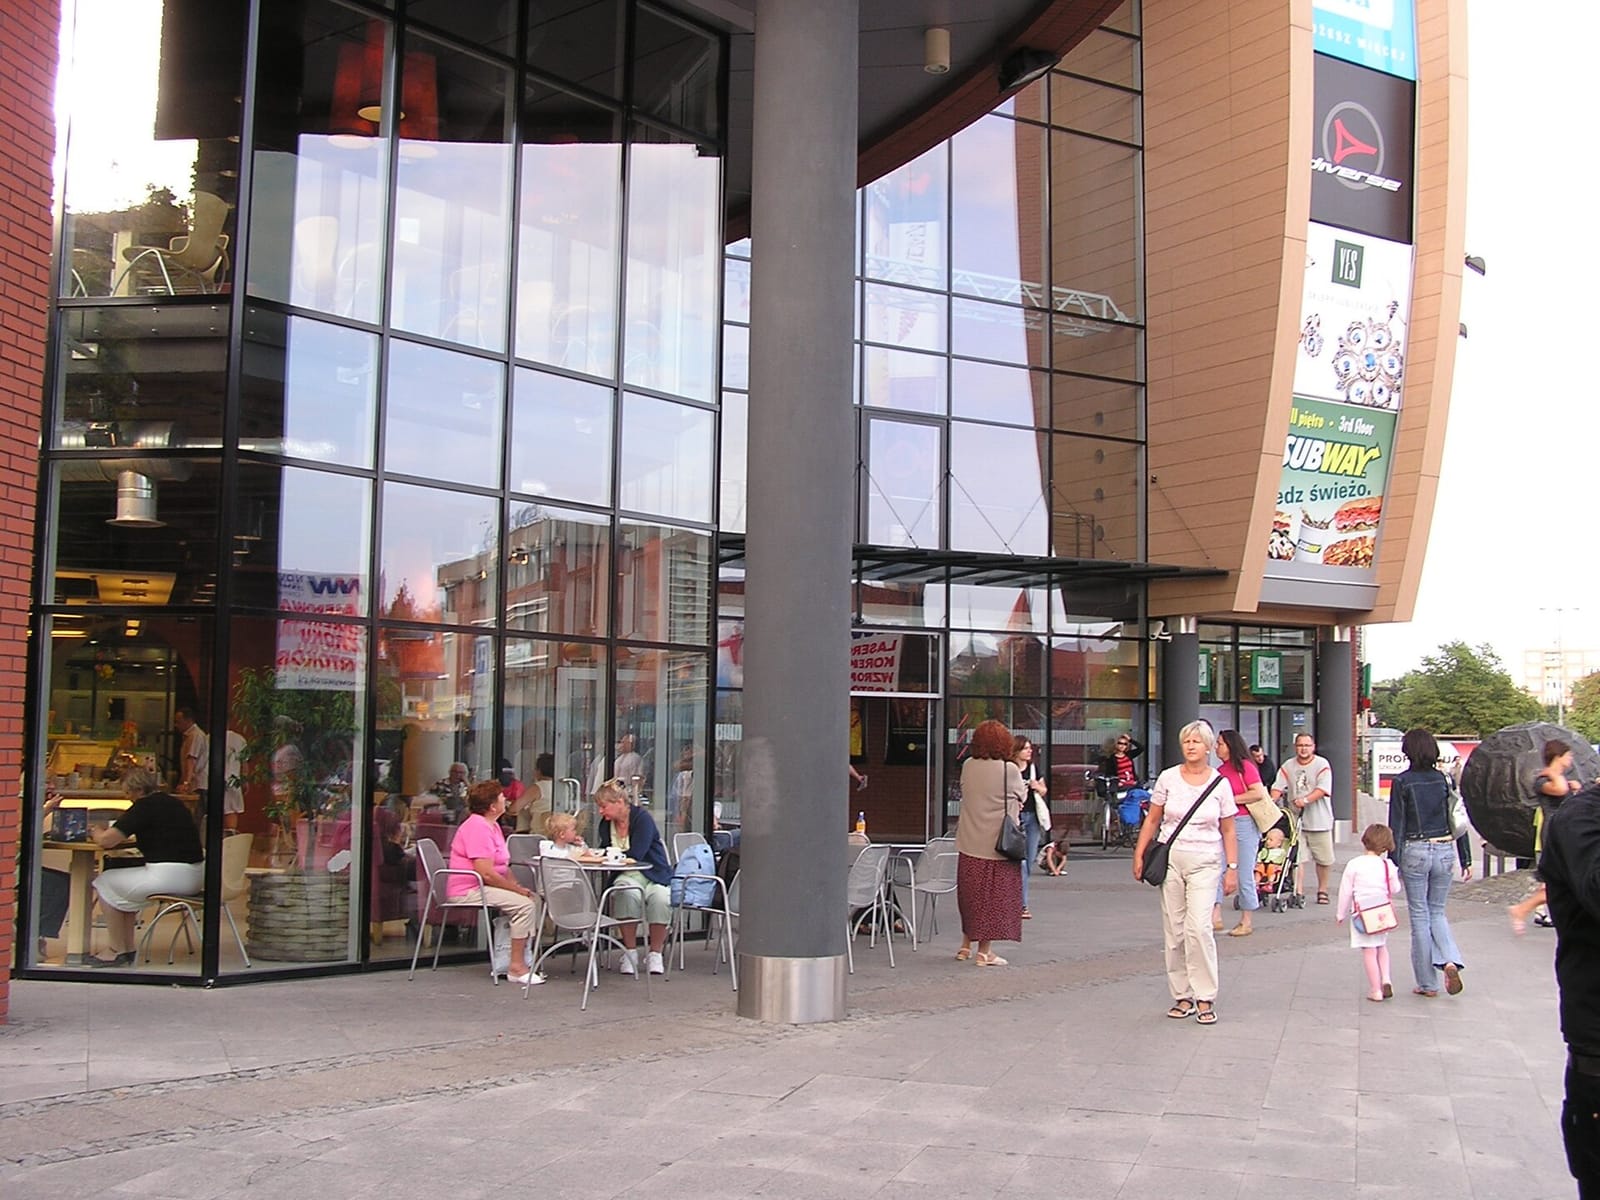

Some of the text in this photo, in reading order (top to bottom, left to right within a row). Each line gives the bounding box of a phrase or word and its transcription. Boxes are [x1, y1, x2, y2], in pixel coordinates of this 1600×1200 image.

[1339, 247, 1359, 281] YES
[1283, 433, 1381, 478] SUBWAY
[1309, 480, 1371, 502] świeżo.
